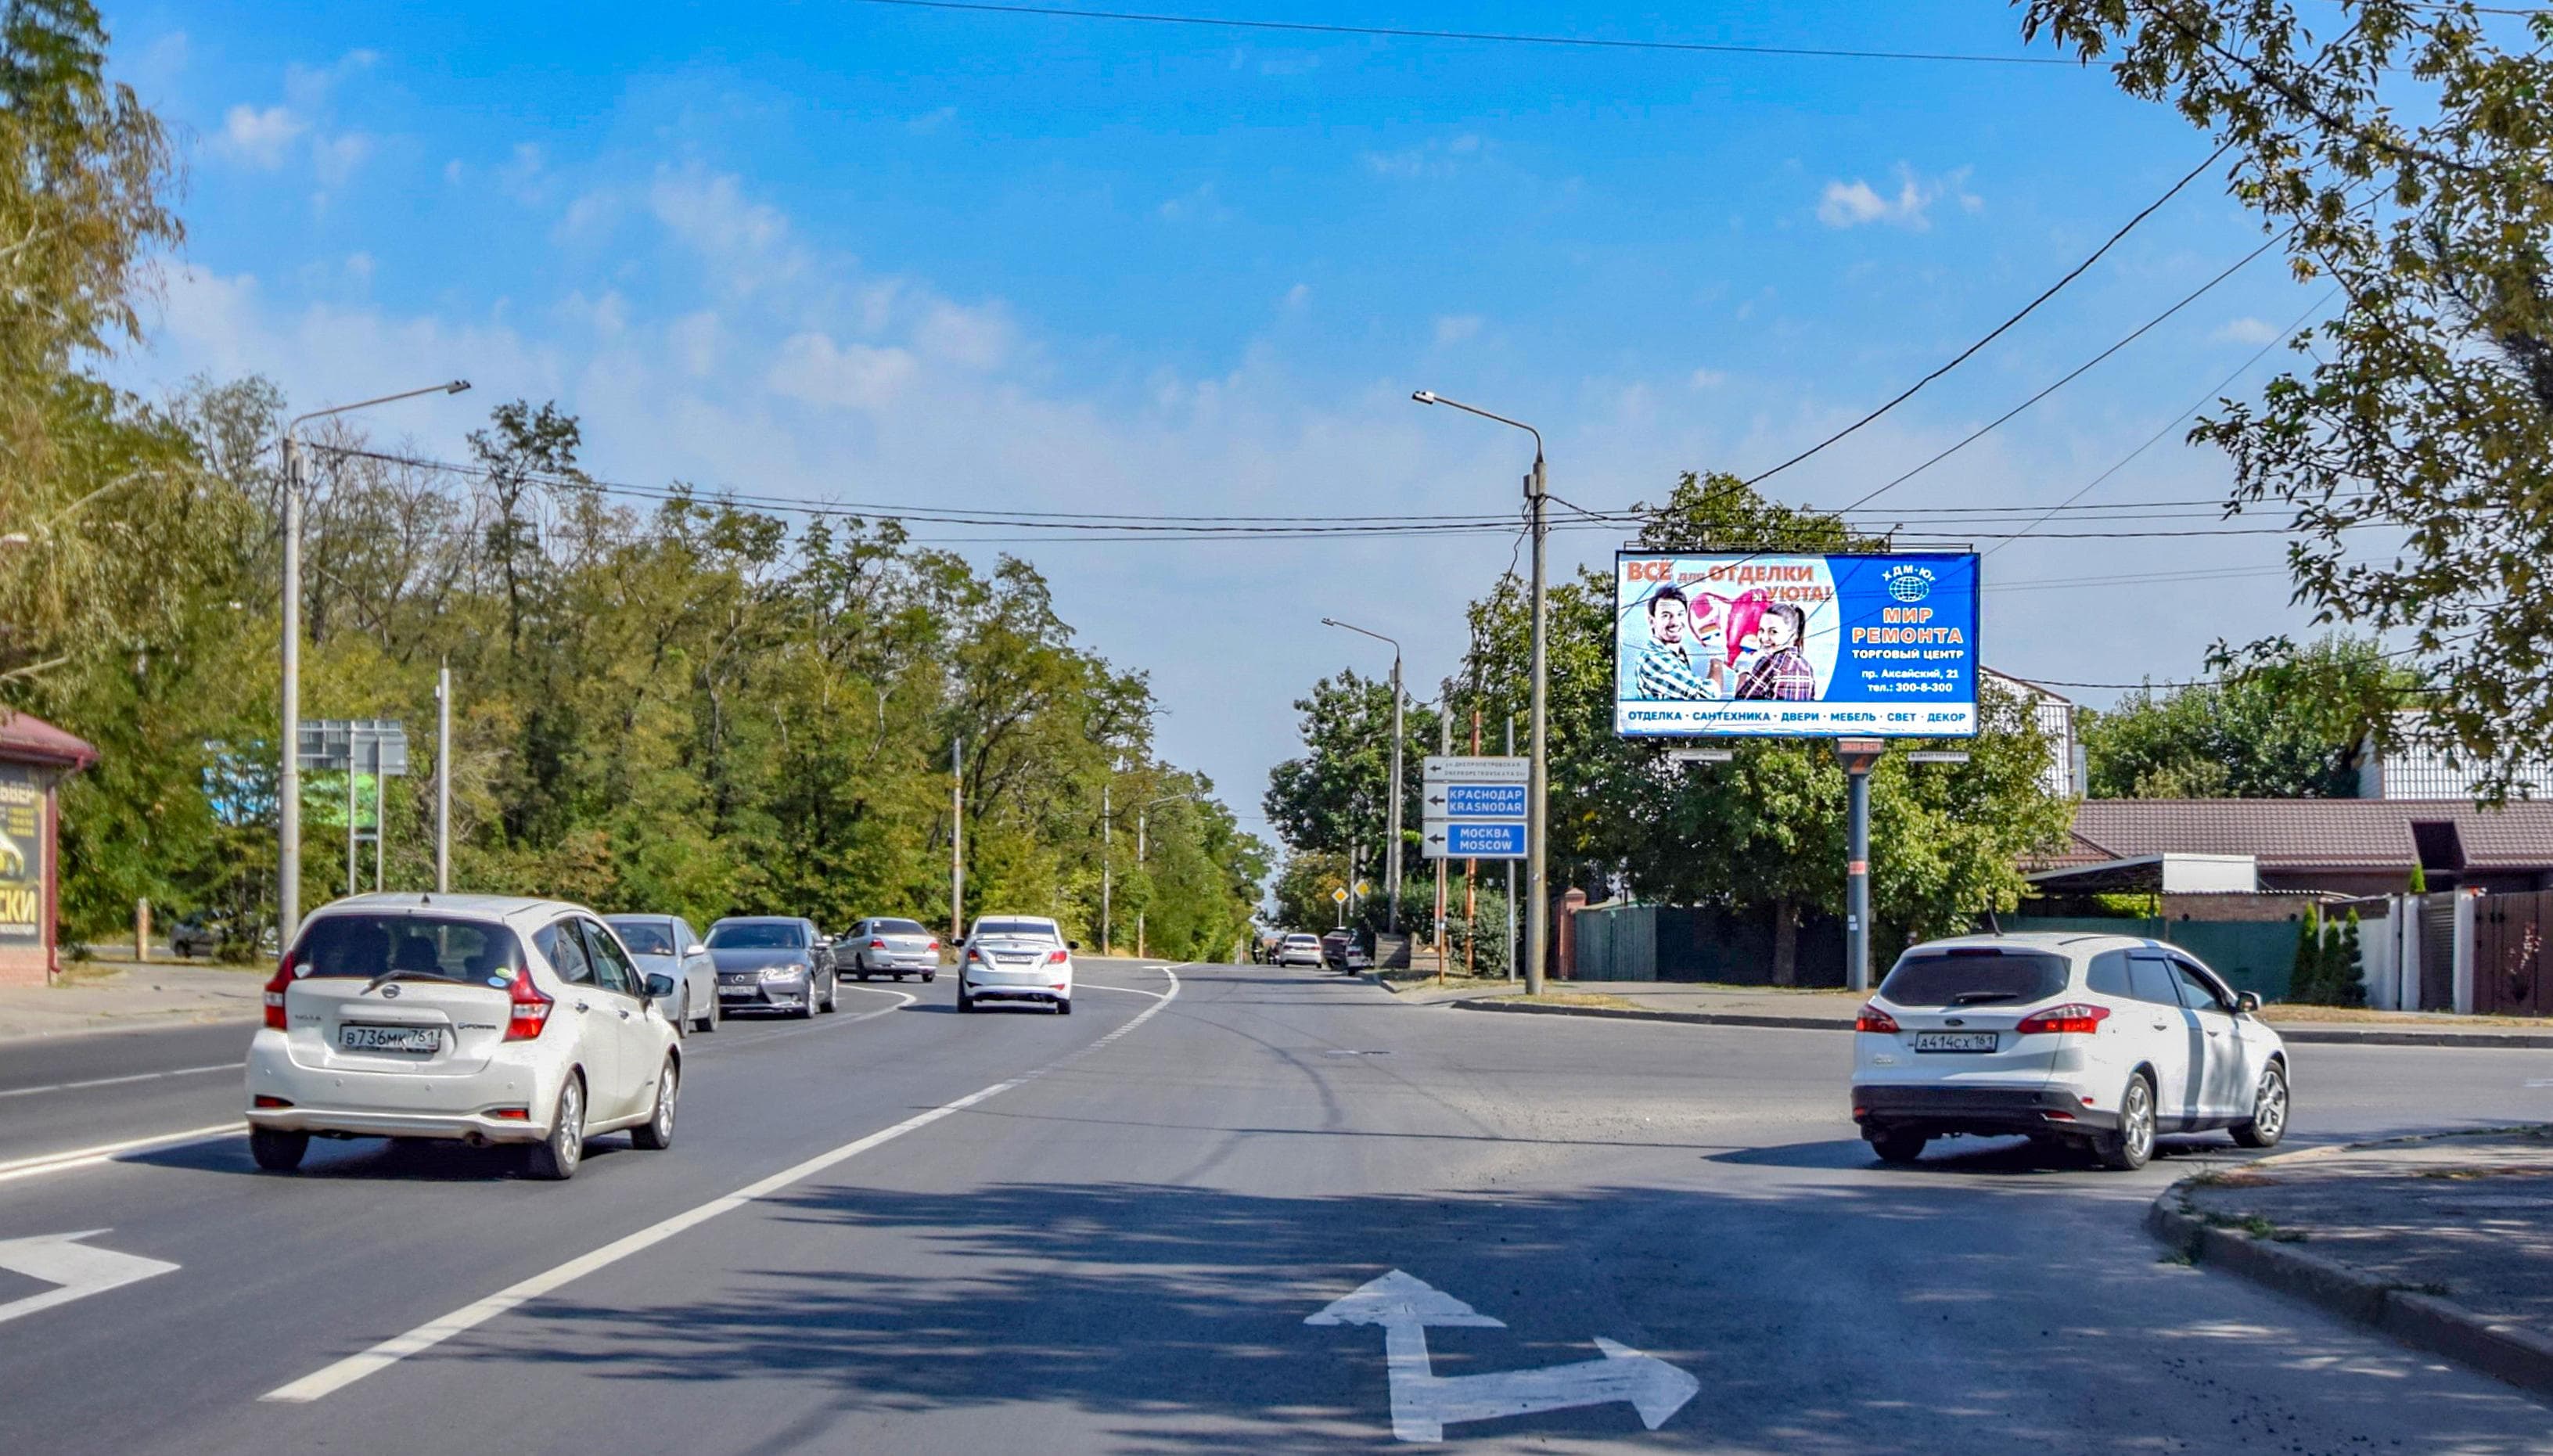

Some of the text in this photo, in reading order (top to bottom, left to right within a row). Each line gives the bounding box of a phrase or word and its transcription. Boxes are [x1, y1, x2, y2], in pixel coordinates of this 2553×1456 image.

[1627, 558, 1673, 581] ВСЁ
[1707, 565, 1814, 586] ОТДЕЛКИ
[1766, 587, 1832, 602] УЮТА!
[1883, 608, 1933, 624] МИР
[1852, 627, 1964, 643] РЕМОНТА
[1852, 649, 1964, 660] ТОРГОВЫЙ ЦЕНТР
[1861, 669, 1959, 680] пр. Аксайский, 21
[1896, 683, 1952, 692] 300-8-300
[1628, 711, 1966, 723] ОТДЕЛКА САНТЕХНИКА ДВЕРИ МЕБЕЛЬ СВЕТ ДЕКОР
[1449, 789, 1523, 800] КРАСНОДАР
[1449, 802, 1523, 812] KRASNODAR
[1460, 828, 1510, 839] МОСКВА
[1460, 841, 1512, 850] MOSCOW
[347, 1026, 408, 1046] В736МК
[1920, 1035, 1994, 1048] А414СХ 161
